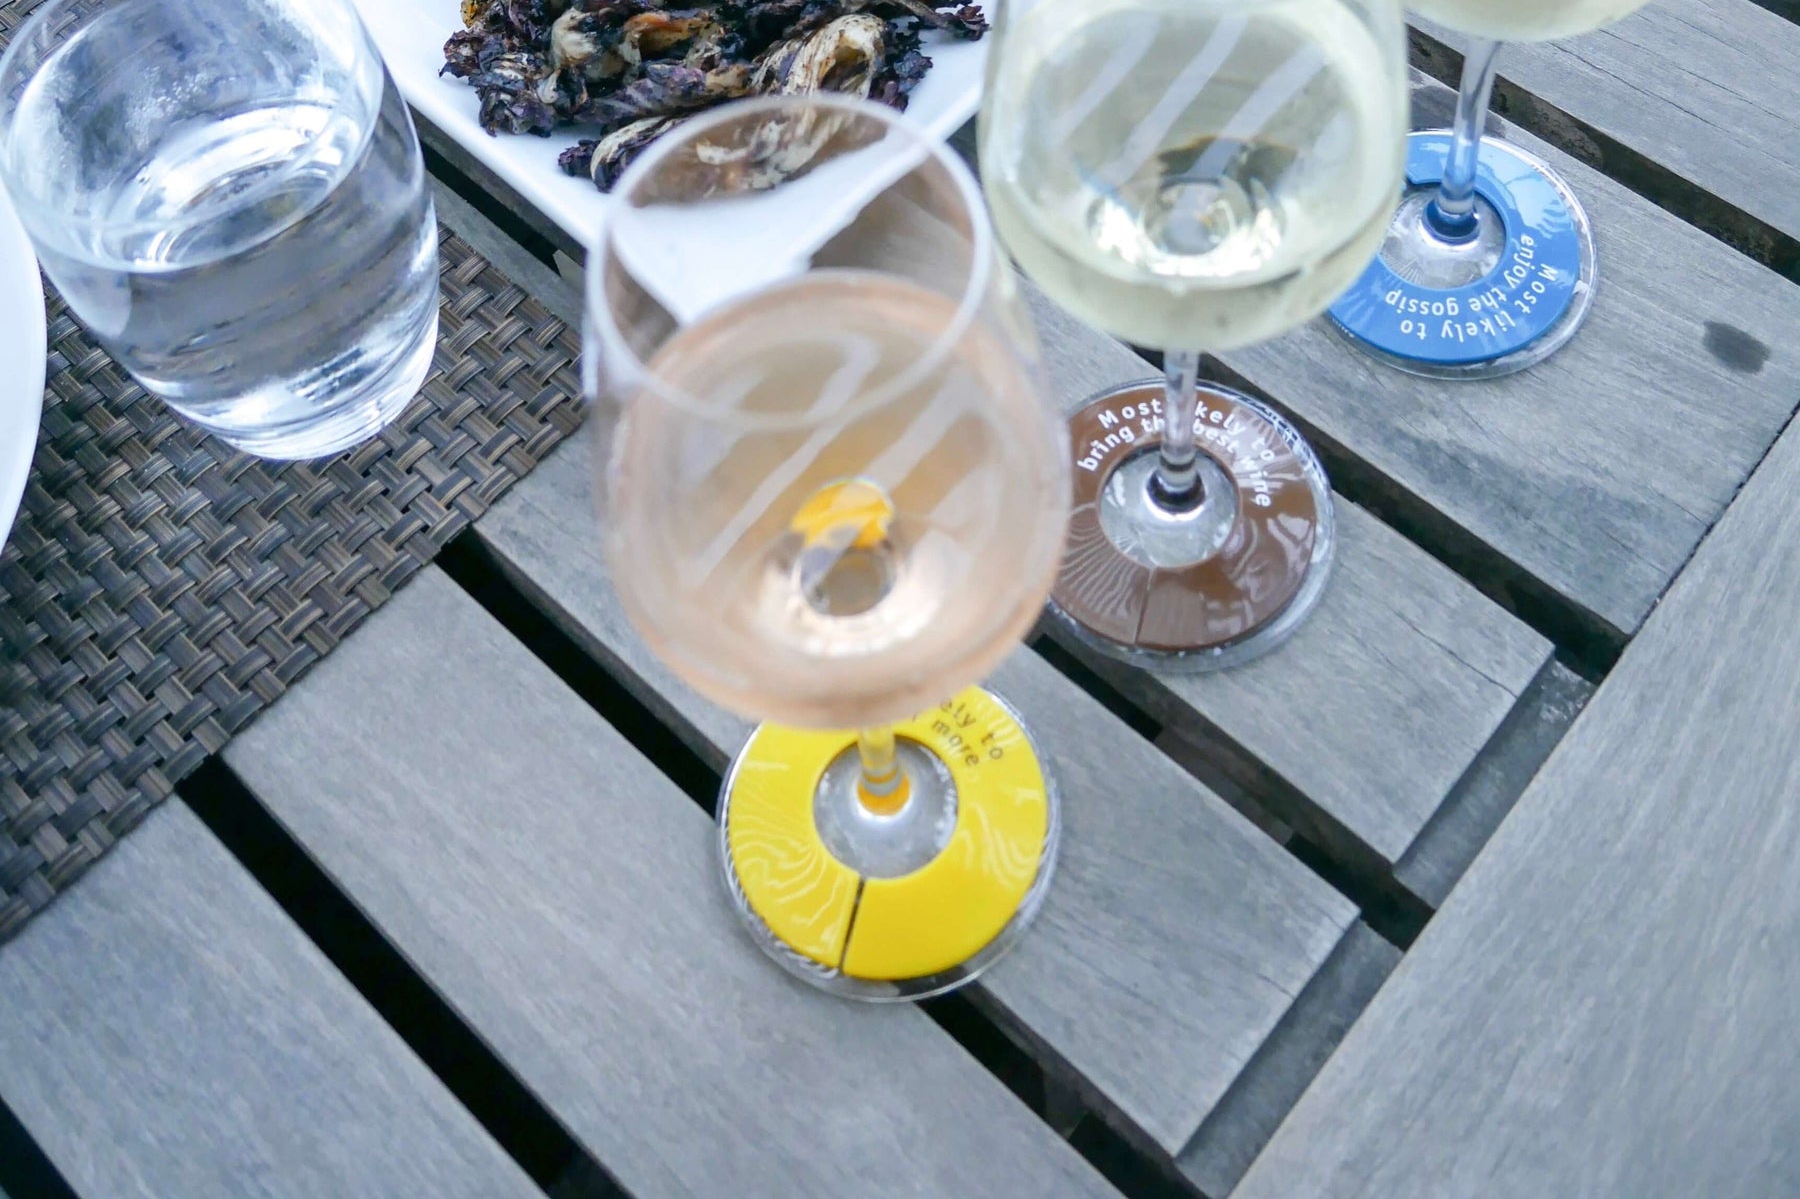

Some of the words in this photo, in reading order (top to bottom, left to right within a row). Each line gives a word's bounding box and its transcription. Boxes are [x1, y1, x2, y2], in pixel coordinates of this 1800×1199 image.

[1503, 234, 1535, 289] enjoy
[1385, 289, 1459, 316] gossip
[1468, 287, 1507, 312] the
[1515, 263, 1559, 314] Most
[1400, 319, 1427, 340] to
[1441, 310, 1516, 343] likely
[1098, 398, 1162, 429] Most
[1194, 401, 1246, 435] kely
[1251, 436, 1275, 461] to
[1077, 425, 1135, 472] bring
[1140, 415, 1165, 433] th
[1192, 419, 1240, 453] best
[1241, 454, 1271, 507] wine
[931, 719, 979, 766] more
[981, 732, 1003, 760] to
